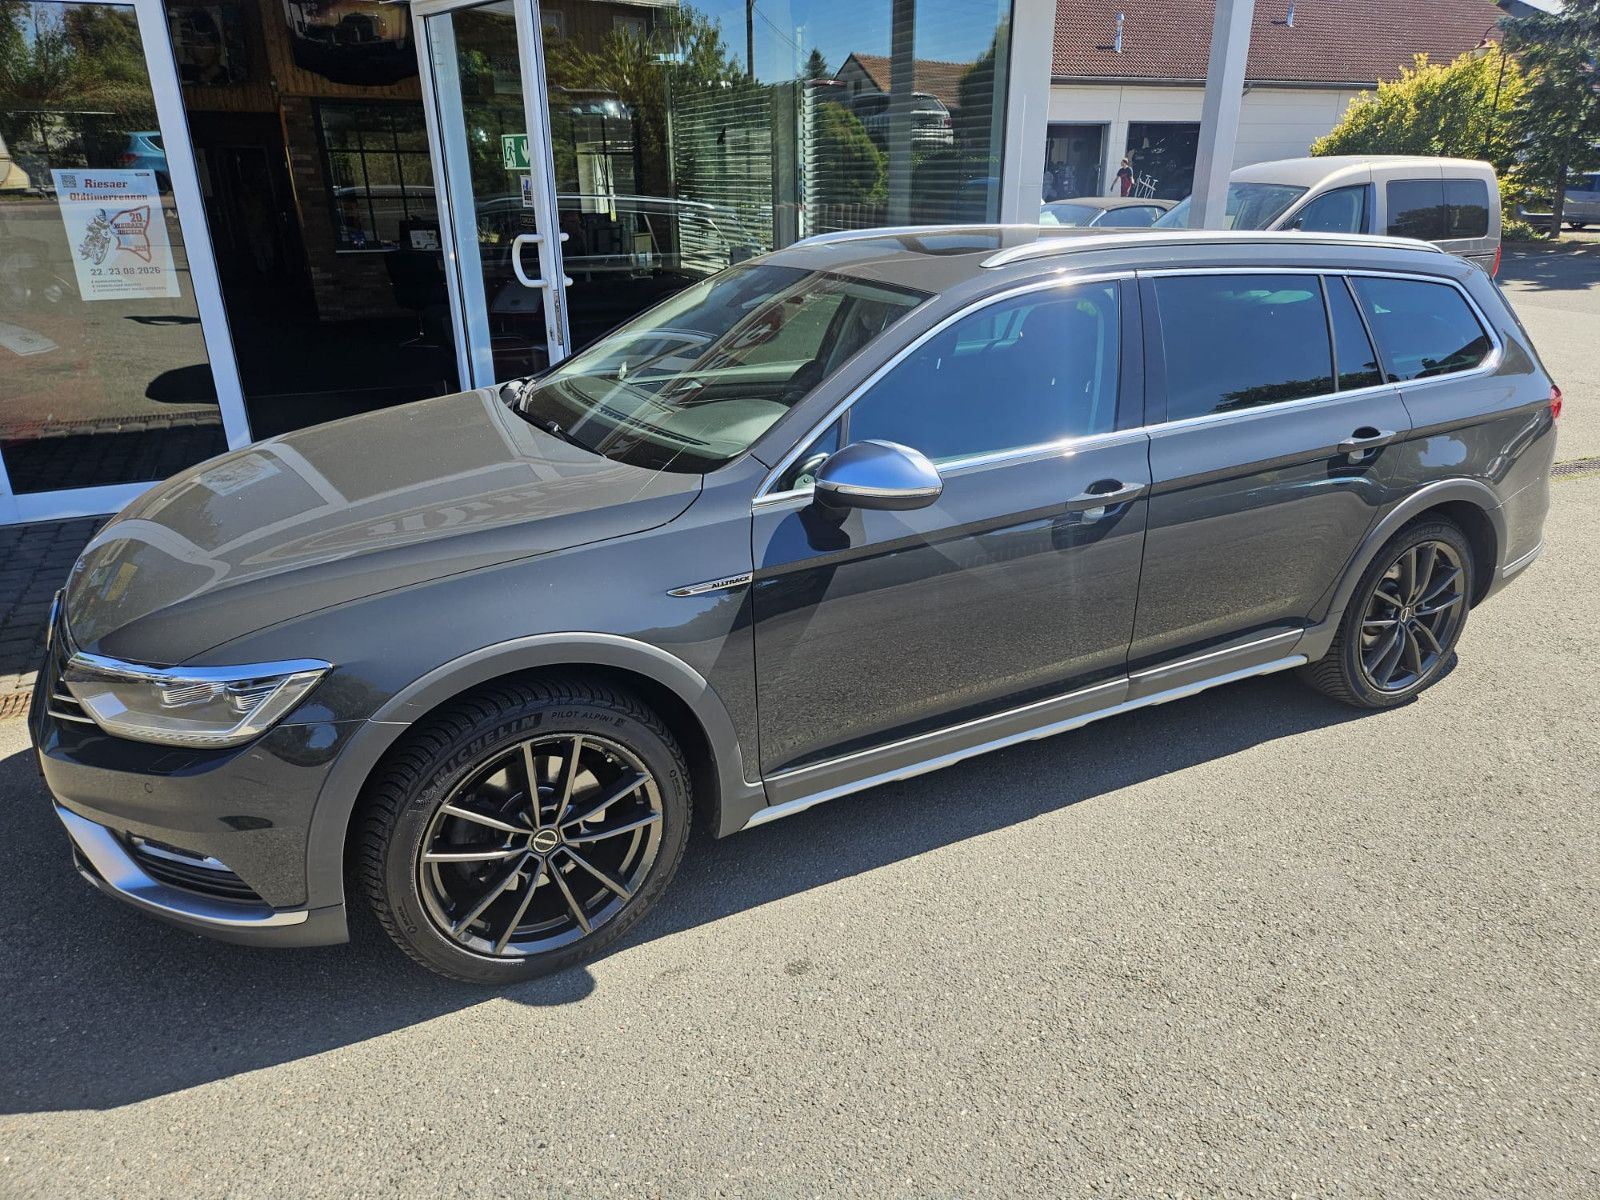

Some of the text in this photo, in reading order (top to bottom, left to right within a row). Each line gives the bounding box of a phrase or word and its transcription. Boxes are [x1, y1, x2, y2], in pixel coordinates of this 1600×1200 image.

[85, 179, 128, 188] Riesaer
[70, 193, 148, 201] Oldtimerrennen
[711, 576, 750, 588] ALLTRACK
[433, 715, 538, 787] MICHELIN
[551, 711, 578, 720] PILOT
